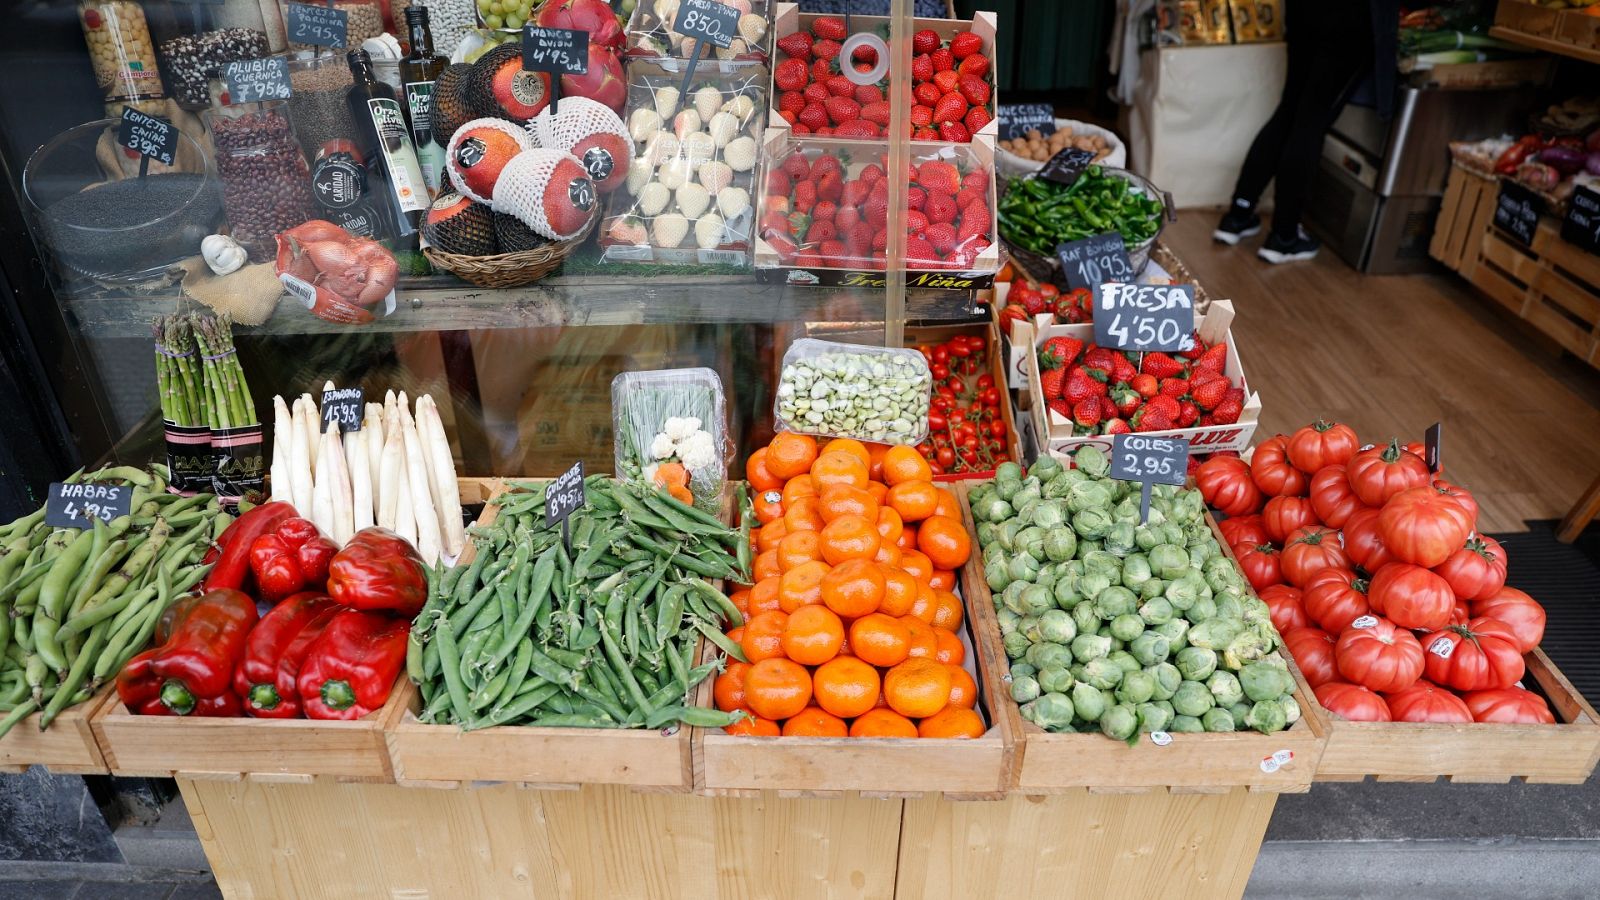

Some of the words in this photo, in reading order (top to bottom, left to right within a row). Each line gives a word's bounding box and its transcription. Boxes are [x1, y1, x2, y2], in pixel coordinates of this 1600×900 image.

[291, 5, 337, 17] LENTEJA
[228, 59, 278, 75] ALUBIA
[234, 70, 283, 83] GUERNICA
[123, 109, 169, 133] LENTEJA
[131, 126, 166, 146] CAVIAR
[332, 171, 344, 203] CARIDAD
[1060, 247, 1081, 263] RAF
[1100, 283, 1192, 312] FRESA
[1107, 313, 1180, 347] 4'50
[1123, 435, 1174, 453] COLES
[1189, 428, 1244, 446] LUZ
[1122, 453, 1176, 476] 2,95
[60, 484, 120, 500] HABAS
